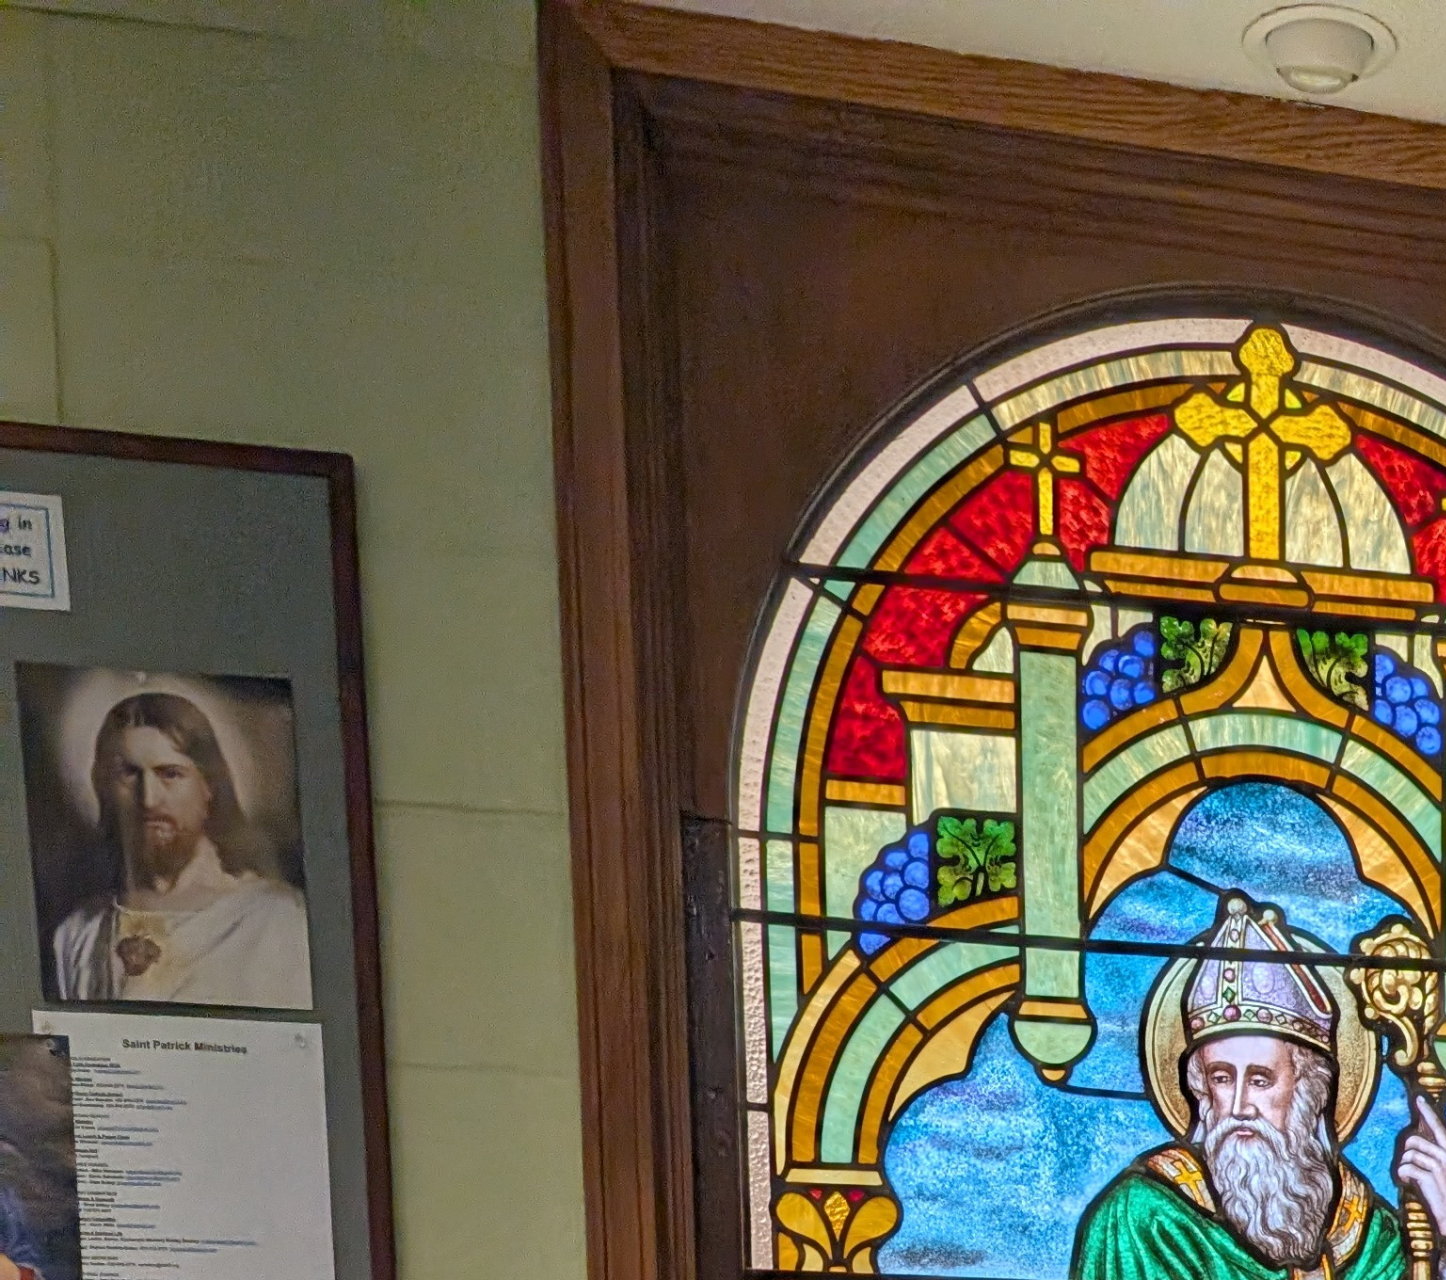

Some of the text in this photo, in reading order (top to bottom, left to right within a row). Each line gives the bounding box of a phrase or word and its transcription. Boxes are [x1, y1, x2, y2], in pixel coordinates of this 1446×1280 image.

[0, 543, 32, 557] ase
[0, 566, 40, 585] NKS
[122, 1038, 248, 1054] Saint Patrick Ministries
